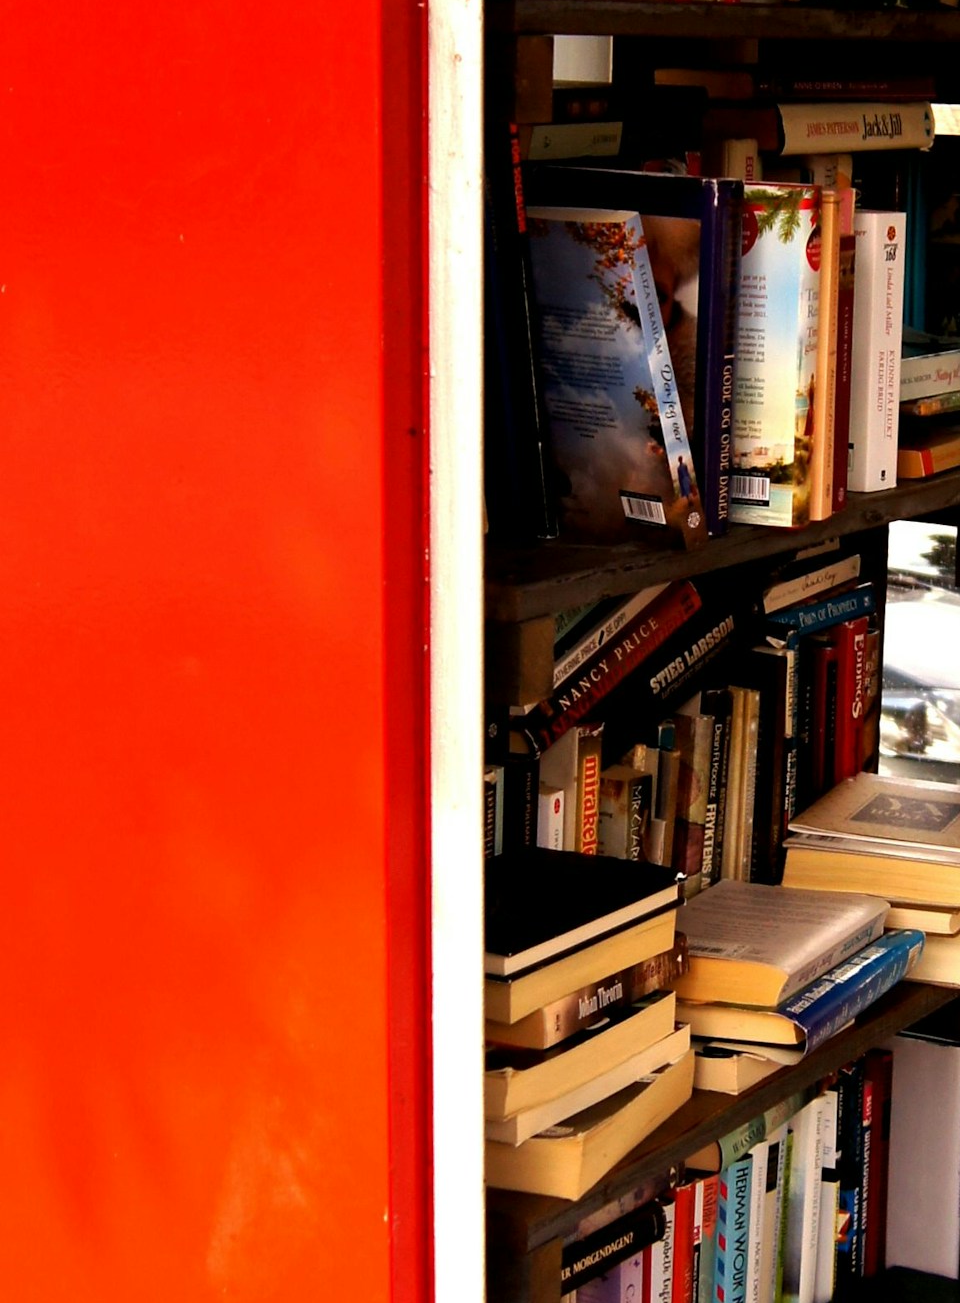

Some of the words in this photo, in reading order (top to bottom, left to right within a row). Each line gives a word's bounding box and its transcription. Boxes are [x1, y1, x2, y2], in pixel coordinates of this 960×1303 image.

[806, 122, 826, 137] JAMES
[826, 121, 860, 136] PATTERSON
[885, 247, 898, 262] 168
[638, 263, 653, 300] ELIZA
[885, 267, 894, 292] Linda
[885, 292, 893, 310] Lael
[645, 301, 663, 355] GRAHAM
[883, 310, 892, 337] Miller
[659, 364, 674, 398] Den
[720, 365, 732, 403] GODE
[877, 350, 885, 385] FARLIG
[888, 350, 896, 390] KVINNE
[662, 400, 676, 421] jeg
[876, 386, 884, 412] BRUD
[886, 392, 895, 405] PÅ
[671, 422, 682, 444] var
[719, 407, 730, 429] OG
[885, 407, 894, 440] FLUKT
[718, 434, 730, 471] ONDE
[717, 475, 729, 521] DAGER
[558, 658, 610, 712] NANCY
[613, 616, 660, 661] PRICE
[650, 655, 686, 695] STIEG
[683, 614, 735, 670] LARSSON
[714, 723, 723, 750] Dean
[709, 761, 719, 799] Koontz
[701, 803, 718, 876] FRYKTENS
[578, 994, 598, 1020] Johan
[597, 979, 623, 1009] Theorin
[733, 1166, 748, 1231] HERMAN
[572, 1230, 636, 1275] MORGENDAGEN?
[732, 1232, 747, 1291] WOUK
